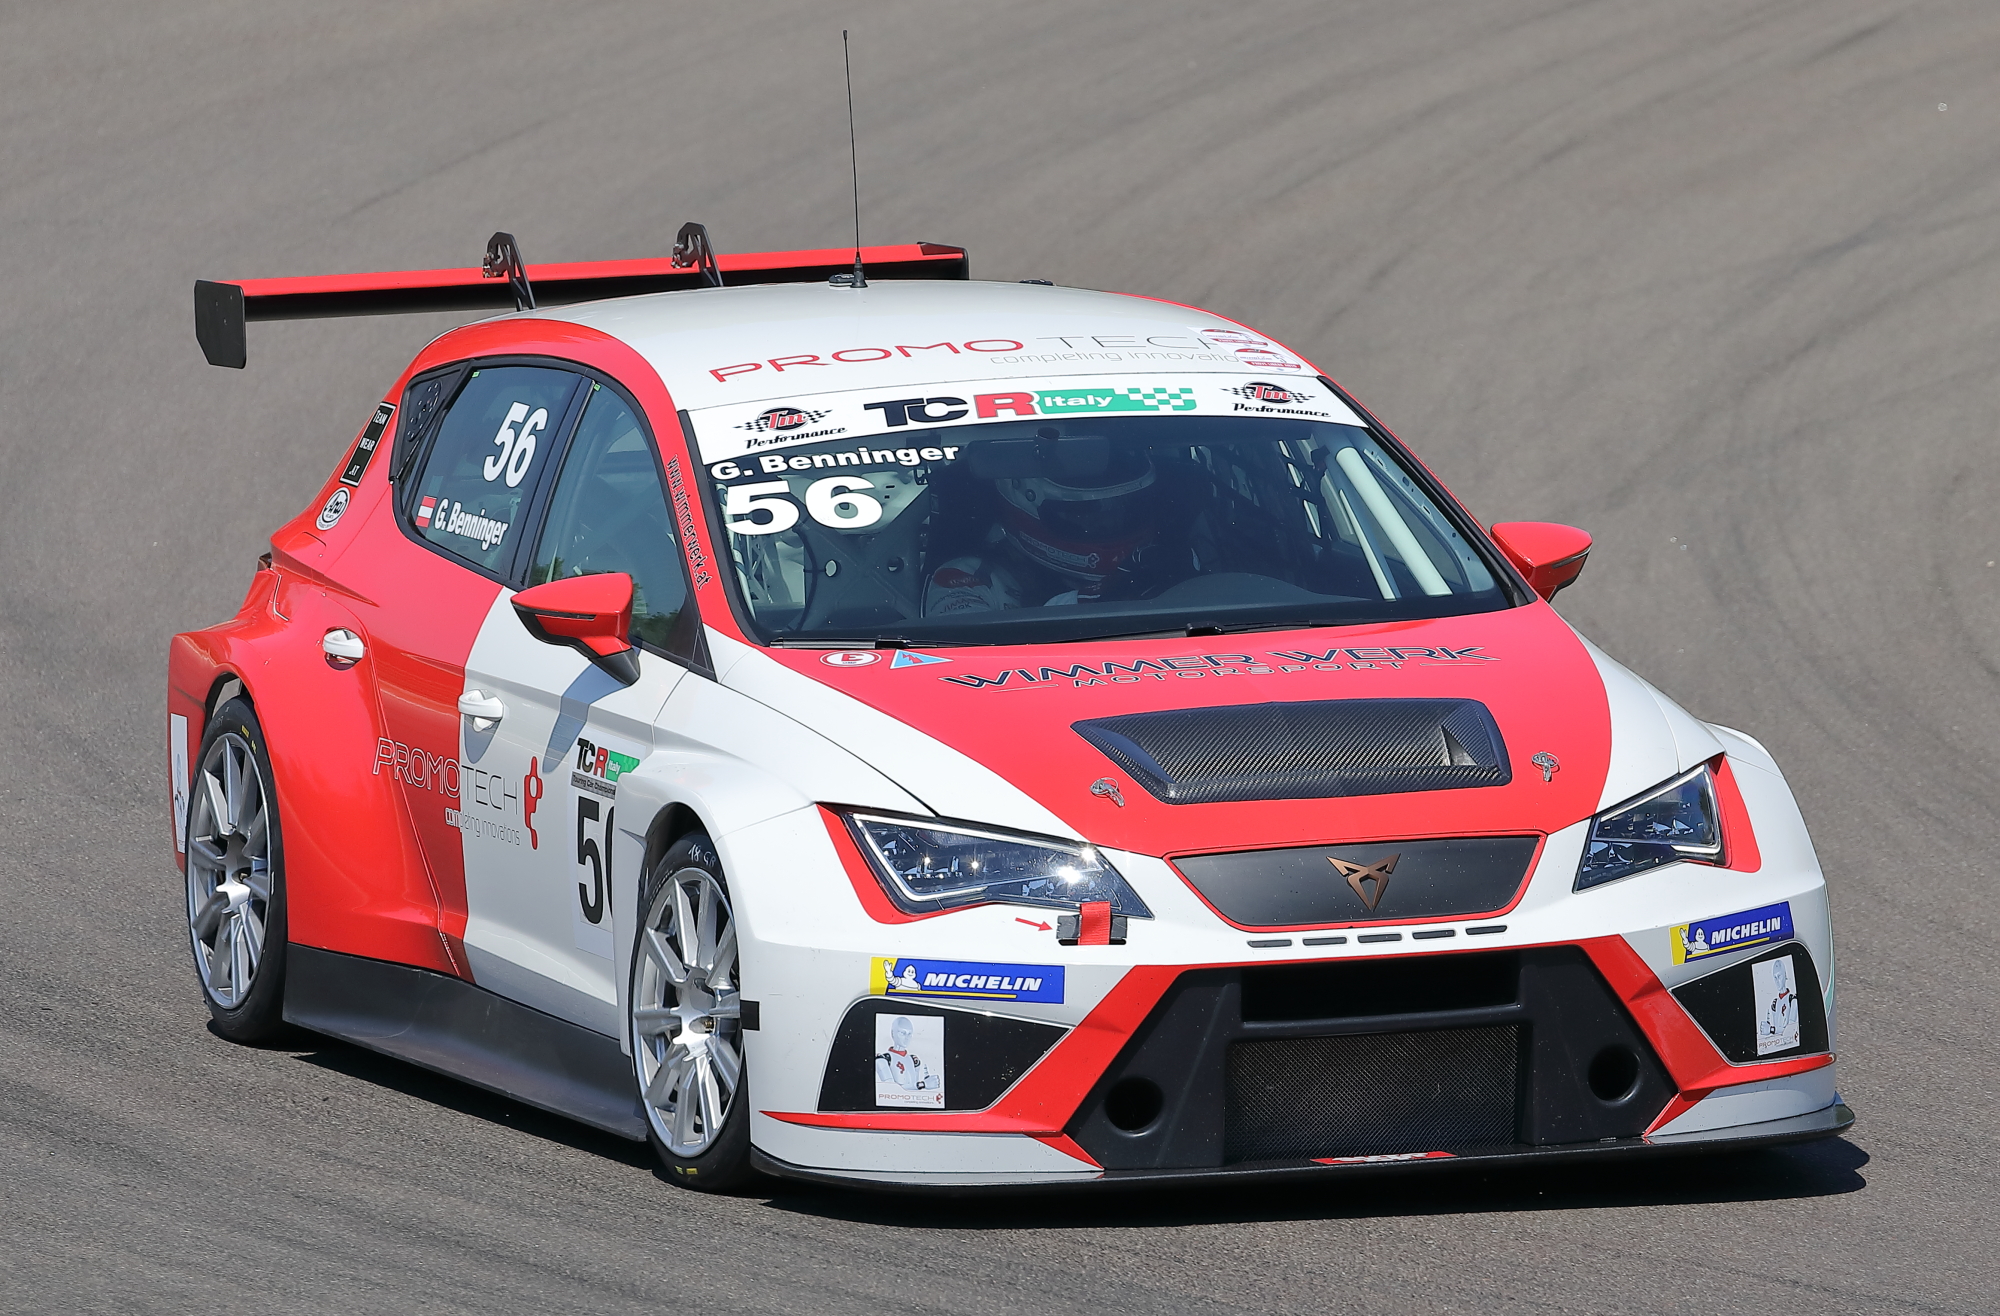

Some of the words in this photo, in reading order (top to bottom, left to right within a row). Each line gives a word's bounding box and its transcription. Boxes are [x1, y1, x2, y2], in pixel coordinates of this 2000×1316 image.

[990, 352, 1122, 364] completing
[1127, 351, 1239, 363] innovatio
[373, 409, 388, 425] TEAM
[863, 391, 1039, 427] TCR
[1044, 394, 1113, 408] Italy
[1232, 402, 1331, 417] Performance
[360, 437, 375, 451] WEAR
[483, 401, 549, 488] 56
[744, 427, 848, 449] Performance
[710, 461, 754, 480] G.
[758, 446, 960, 473] Benninger
[725, 475, 883, 536] 56
[434, 498, 447, 531] G.
[446, 501, 509, 551] Benninger
[666, 454, 712, 590] www.wimmerwerk.at
[938, 653, 1267, 688] WIMMER
[1266, 647, 1502, 662] WERK
[1073, 661, 1403, 688] MOTORSPORT
[577, 737, 608, 778] TCR
[608, 760, 621, 775] Italy
[372, 737, 518, 815] PROMOTECH
[1711, 917, 1781, 945] MICHELIN
[923, 973, 1042, 991] MICHELIN
[878, 1093, 935, 1101] PROMOTECH
